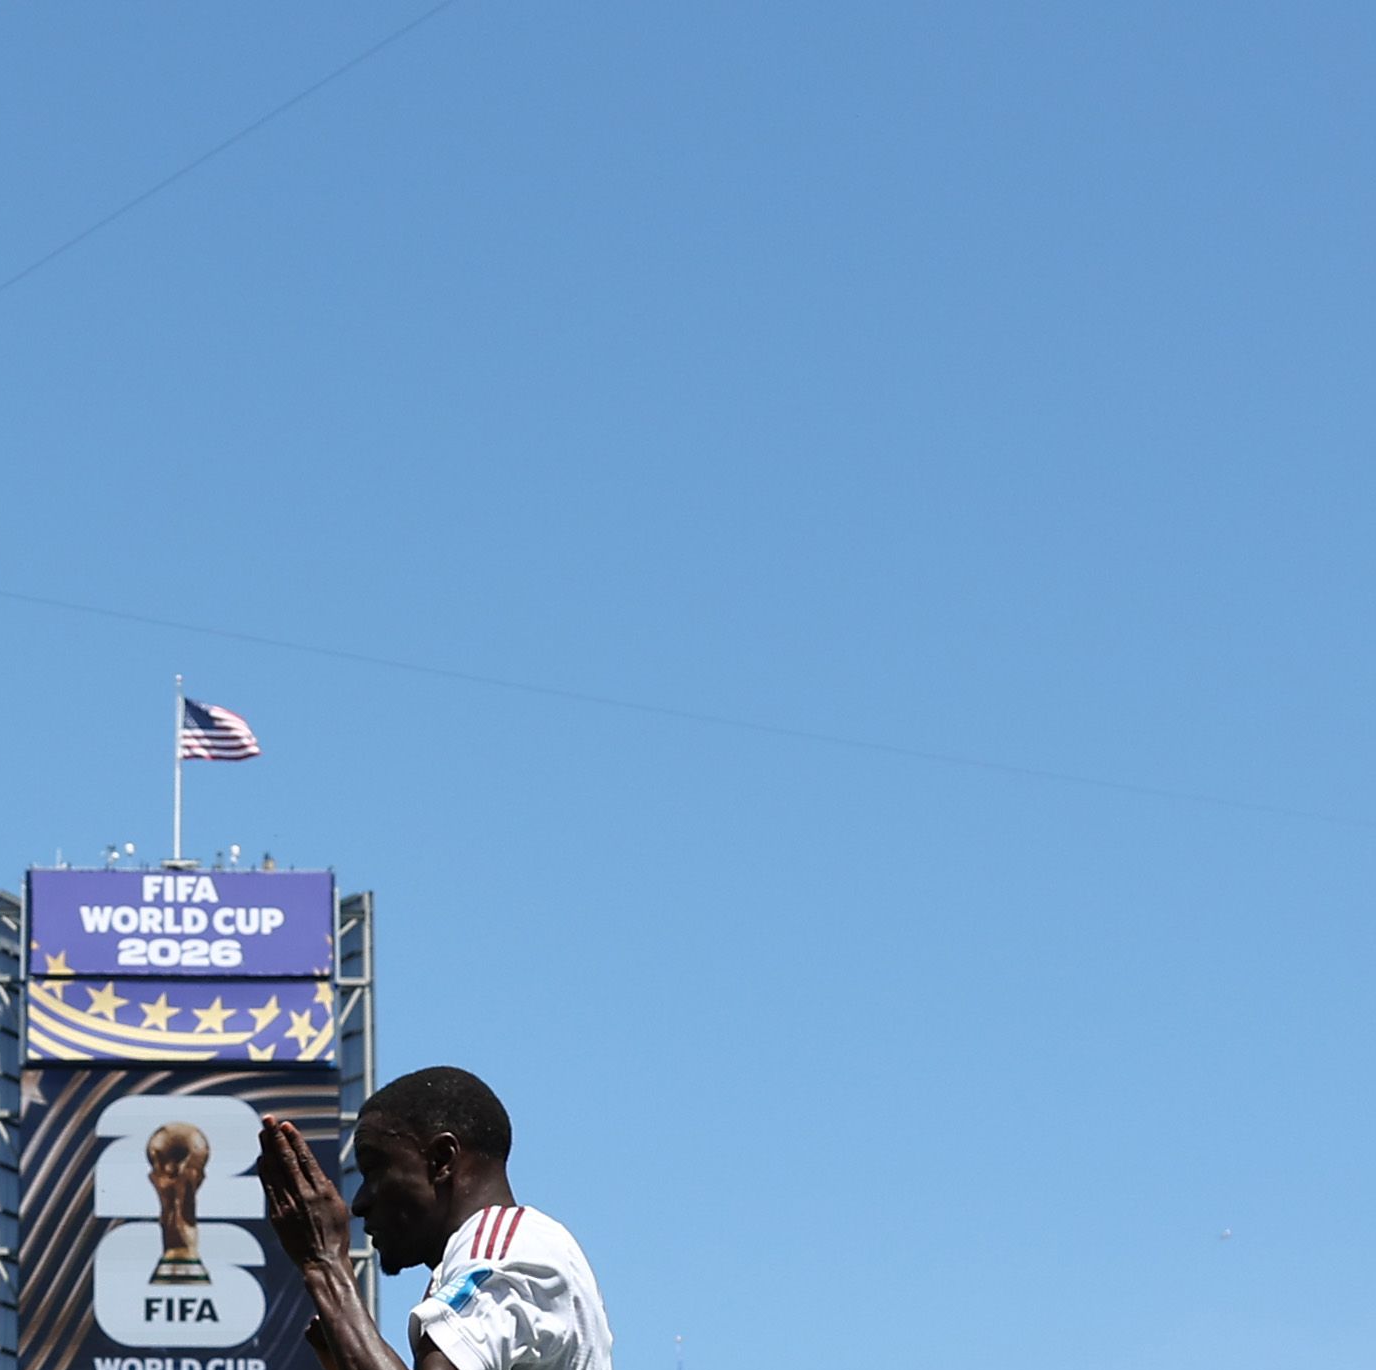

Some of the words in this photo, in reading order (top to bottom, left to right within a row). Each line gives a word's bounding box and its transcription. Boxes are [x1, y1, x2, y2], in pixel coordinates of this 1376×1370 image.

[142, 875, 219, 903] FIFA
[80, 906, 208, 935] WORLD
[213, 907, 284, 936] CUP
[117, 938, 243, 967] 2026
[144, 1297, 219, 1323] FIFA
